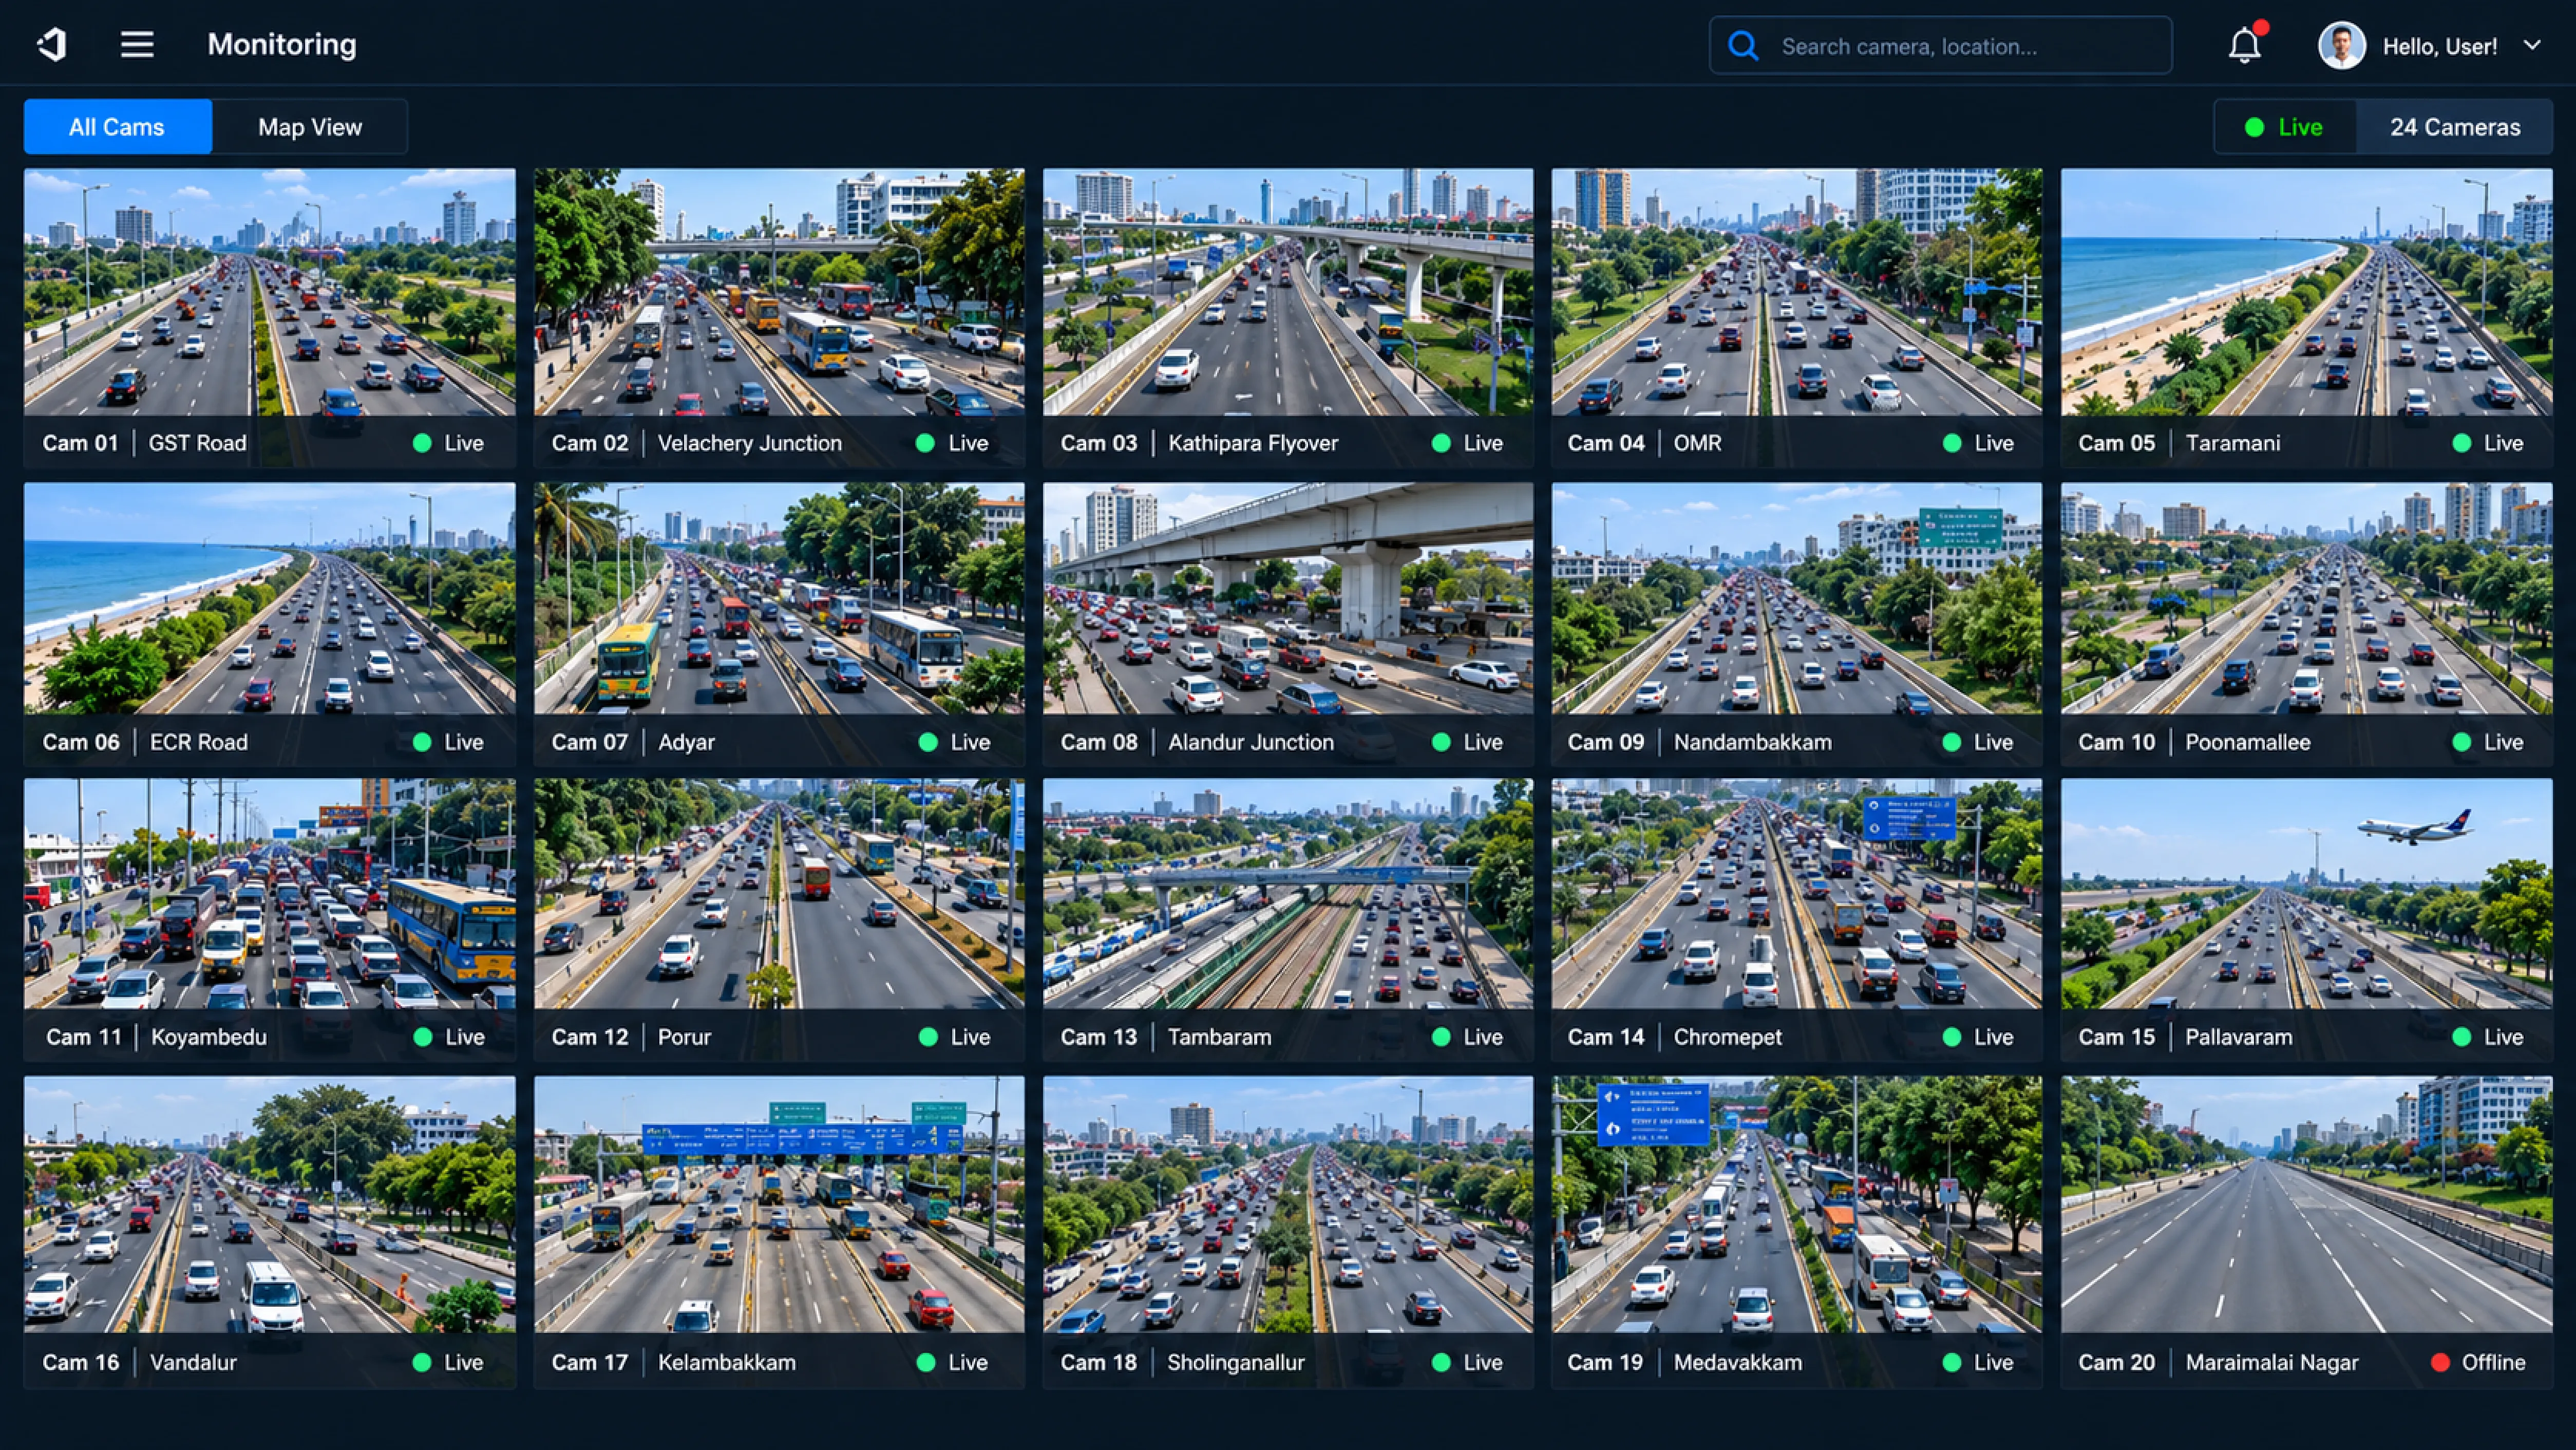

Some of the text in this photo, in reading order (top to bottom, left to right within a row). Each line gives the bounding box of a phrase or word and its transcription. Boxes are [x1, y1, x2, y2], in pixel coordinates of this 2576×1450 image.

[207, 32, 356, 62] Monitoring
[1782, 36, 2037, 58] Search camera, location...
[2384, 36, 2496, 58] Hello, User!
[69, 117, 164, 136] All Cams
[260, 117, 363, 141] Map View
[2280, 117, 2323, 136] Live
[2391, 117, 2521, 136] 24 Cameras
[43, 434, 247, 452] Cam 01 GST Road
[446, 434, 484, 452] Live
[553, 434, 842, 457] Cam 02 Velachery Junction
[950, 434, 990, 452] Live
[1061, 434, 1339, 455] Cam 03 Kathipara Flyover
[1465, 434, 1504, 452] Live
[1568, 434, 1721, 452] Cam 04 OMR
[1976, 434, 2014, 452] Live
[2079, 434, 2281, 452] Cam 05 Taramani
[2485, 434, 2524, 452] Live
[43, 733, 247, 751] Cam 06 ECR Road
[445, 733, 484, 751] Live
[553, 733, 715, 756] Cam 07 Adyar
[952, 733, 991, 751] Live
[1061, 733, 1335, 751] Cam 08 Alandur Junction
[1465, 733, 1503, 751] Live
[1568, 733, 1832, 751] Cam 09 Nandambakkam
[1975, 733, 2014, 751] Live
[2079, 733, 2312, 751] Cam 10 Poonamallee
[2485, 733, 2524, 751] Live
[47, 1027, 267, 1050] Cam 11 Koyambedu
[446, 1027, 486, 1045] Live
[553, 1027, 712, 1045] Cam 12 Porur
[952, 1027, 991, 1045] Live
[1061, 1027, 1272, 1045] Cam 13 Tambaram
[1465, 1027, 1504, 1045] Live
[1568, 1027, 1783, 1050] Cam 14 Chromepet
[1975, 1027, 2014, 1045] Live
[2079, 1027, 2293, 1045] Cam 15 Pallavaram
[2485, 1027, 2524, 1045] Live
[43, 1354, 238, 1370] Cam 16 Vandalur
[445, 1354, 484, 1370] Live
[553, 1352, 795, 1370] Cam 17 Kelambakkam
[950, 1354, 988, 1370] Live
[1061, 1352, 1305, 1375] Cam 18 Sholinganallur
[1465, 1354, 1503, 1370] Live
[1568, 1354, 1802, 1370] Cam 19 Medavakkam
[1975, 1352, 2014, 1370] Live
[2079, 1354, 2359, 1375] Cam 20 Maraimalai Nagar
[2463, 1353, 2526, 1370] Offline
